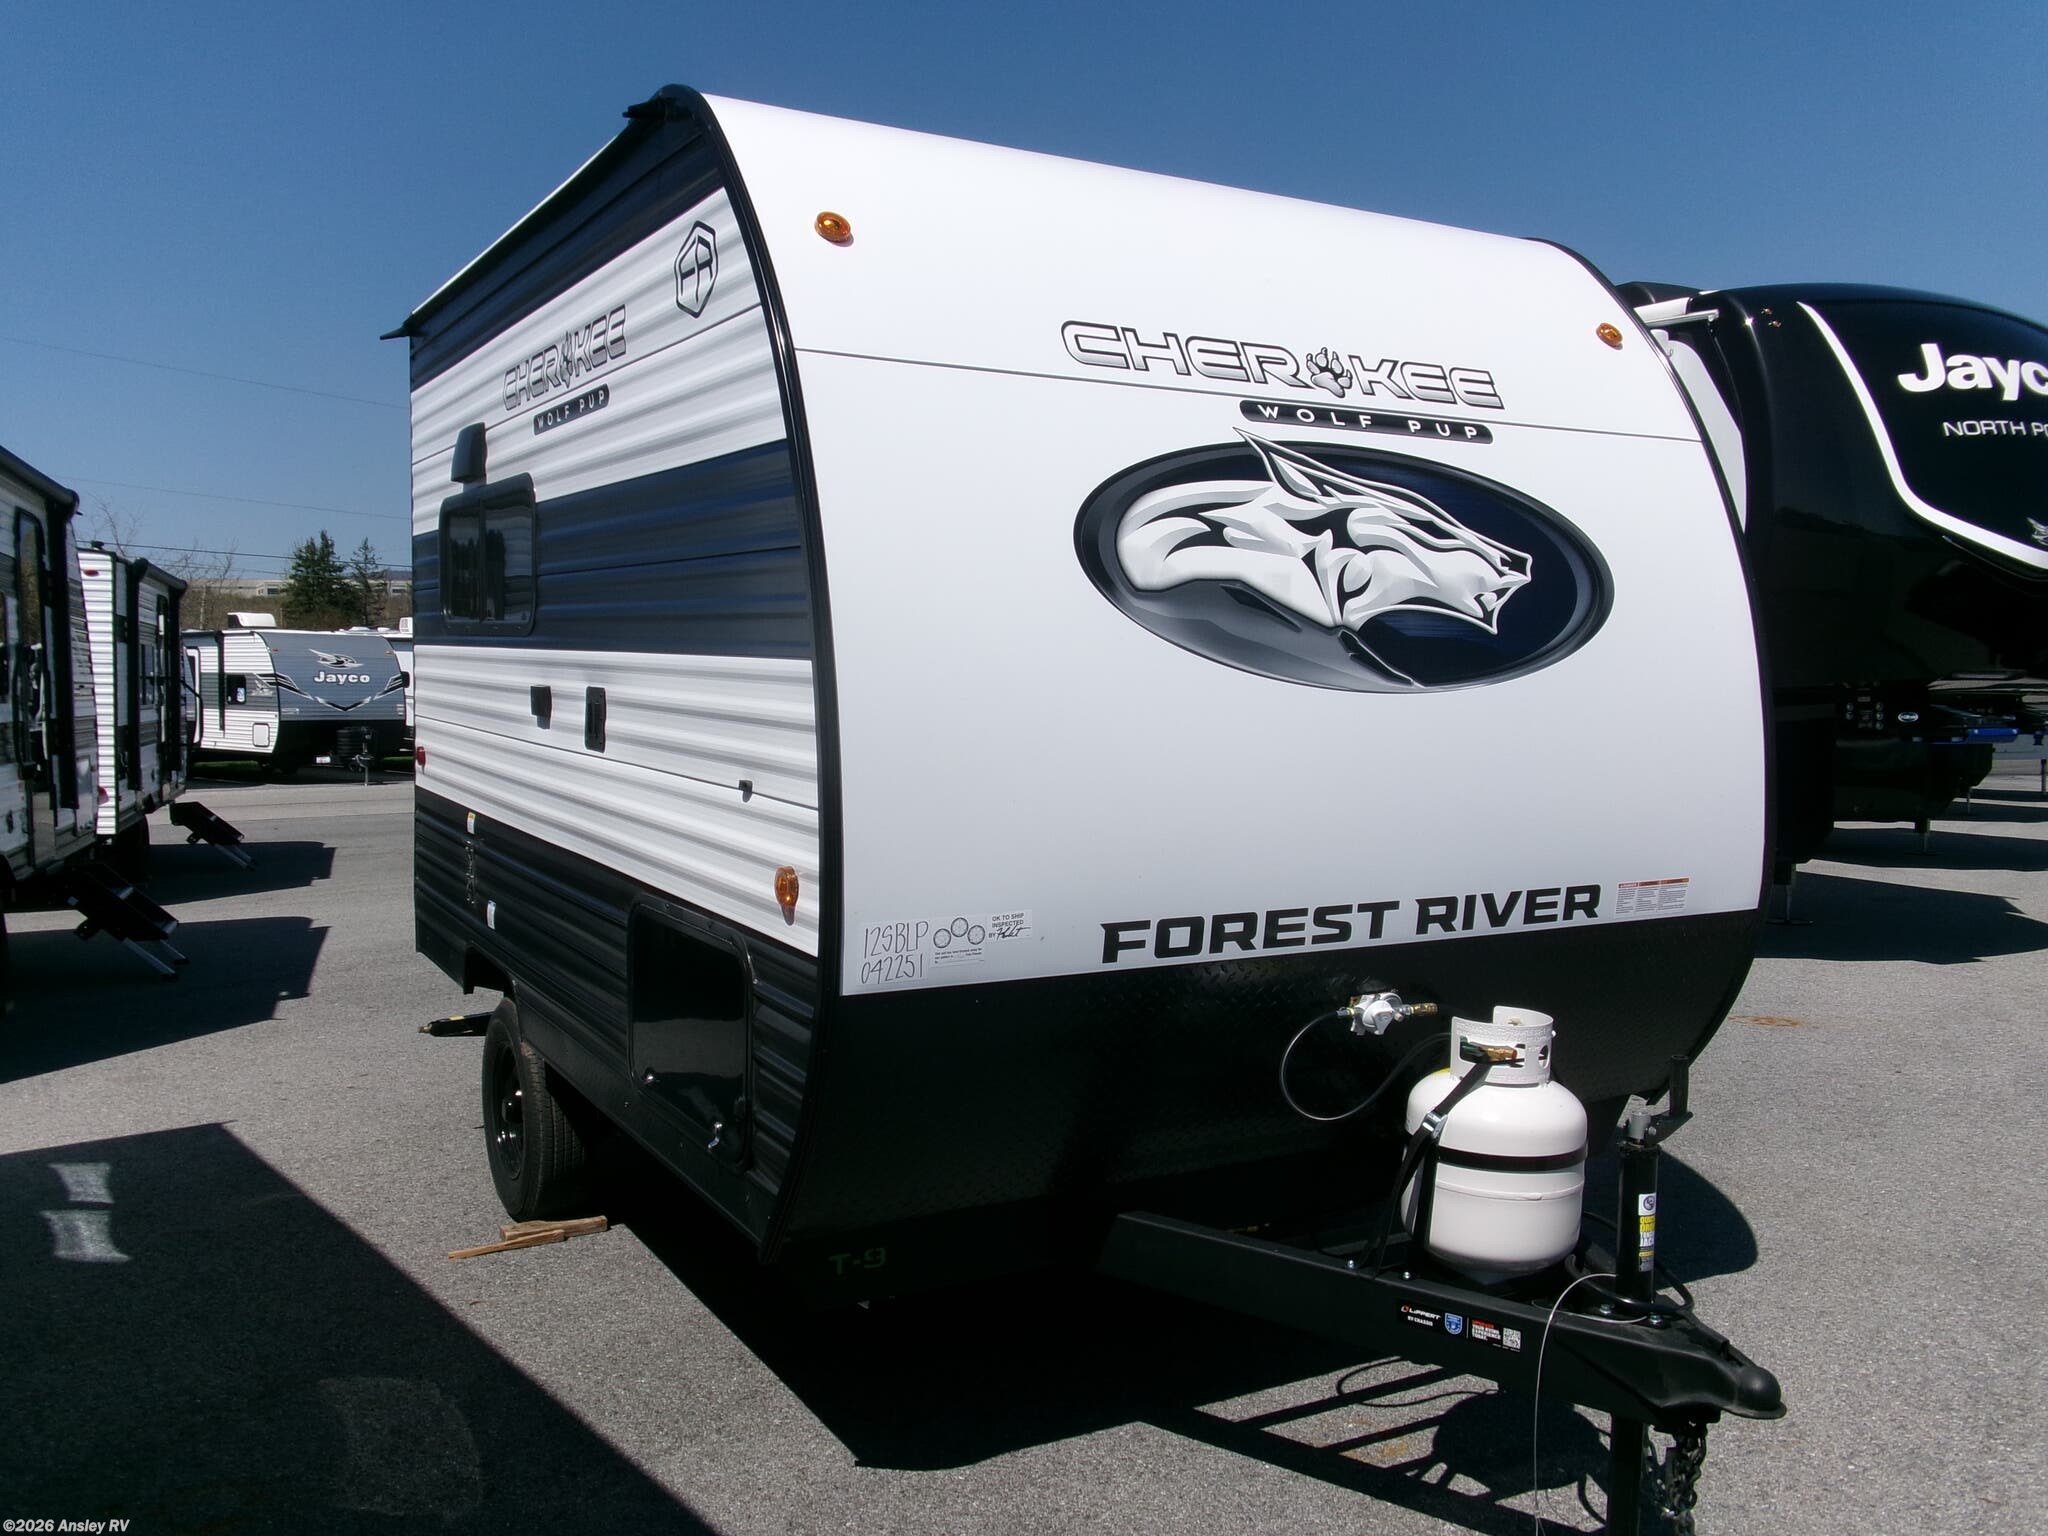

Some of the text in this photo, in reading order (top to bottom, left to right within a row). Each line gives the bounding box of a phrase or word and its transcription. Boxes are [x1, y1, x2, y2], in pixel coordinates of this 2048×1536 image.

[1061, 320, 1505, 409] CHEROKEE
[537, 390, 605, 428] WOLF PUP
[1258, 404, 1478, 439] WOLF PUP
[1942, 420, 2027, 437] NORTH
[313, 671, 371, 685] Jayco
[991, 914, 1000, 922] OK
[1011, 912, 1025, 920] SHIP
[991, 919, 1024, 929] INSPECTED
[1099, 900, 1400, 964] FOREST
[1414, 884, 1601, 935] RIVER
[861, 953, 924, 985] 042251
